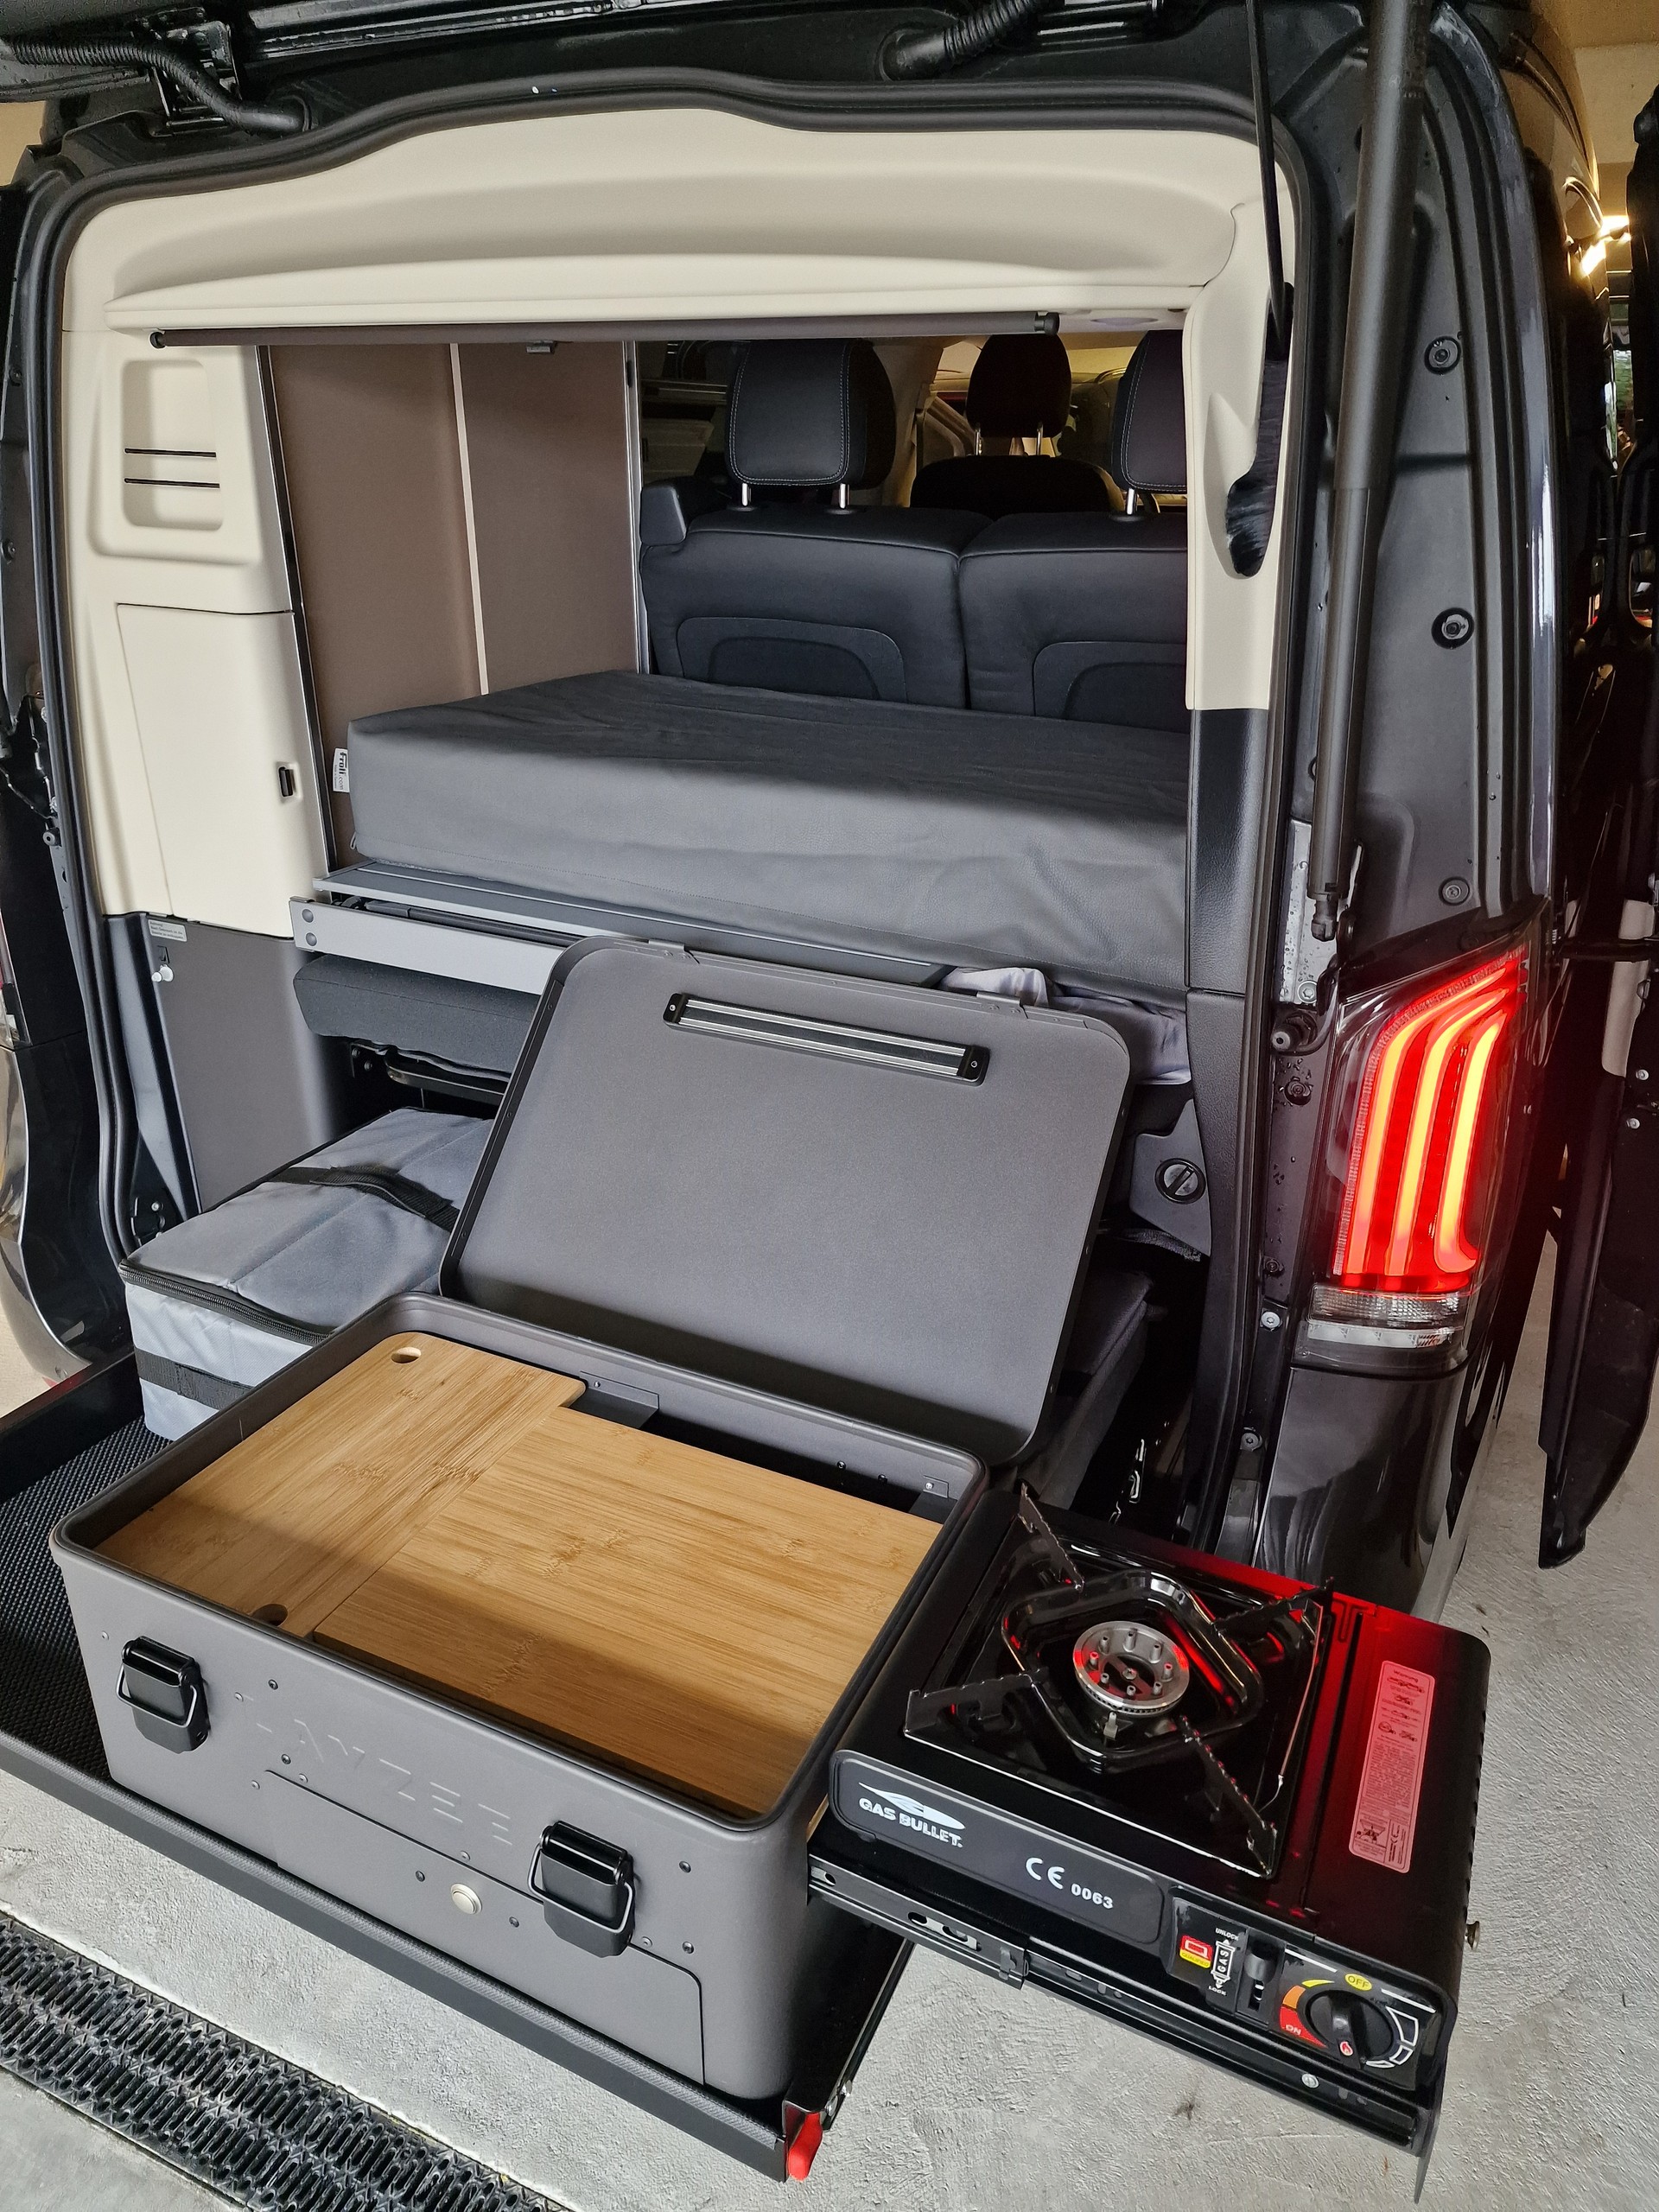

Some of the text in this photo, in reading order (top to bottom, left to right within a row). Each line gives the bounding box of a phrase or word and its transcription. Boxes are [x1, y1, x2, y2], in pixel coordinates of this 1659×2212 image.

[858, 1797, 896, 1821] GAS
[1025, 1857, 1114, 1910] CE 0063
[1215, 1928, 1239, 1941] UNLOCK
[1217, 1949, 1230, 1973] GAS
[1347, 1975, 1370, 1990] OFF
[1208, 1985, 1227, 1996] LOCK
[1285, 2024, 1302, 2037] ON
